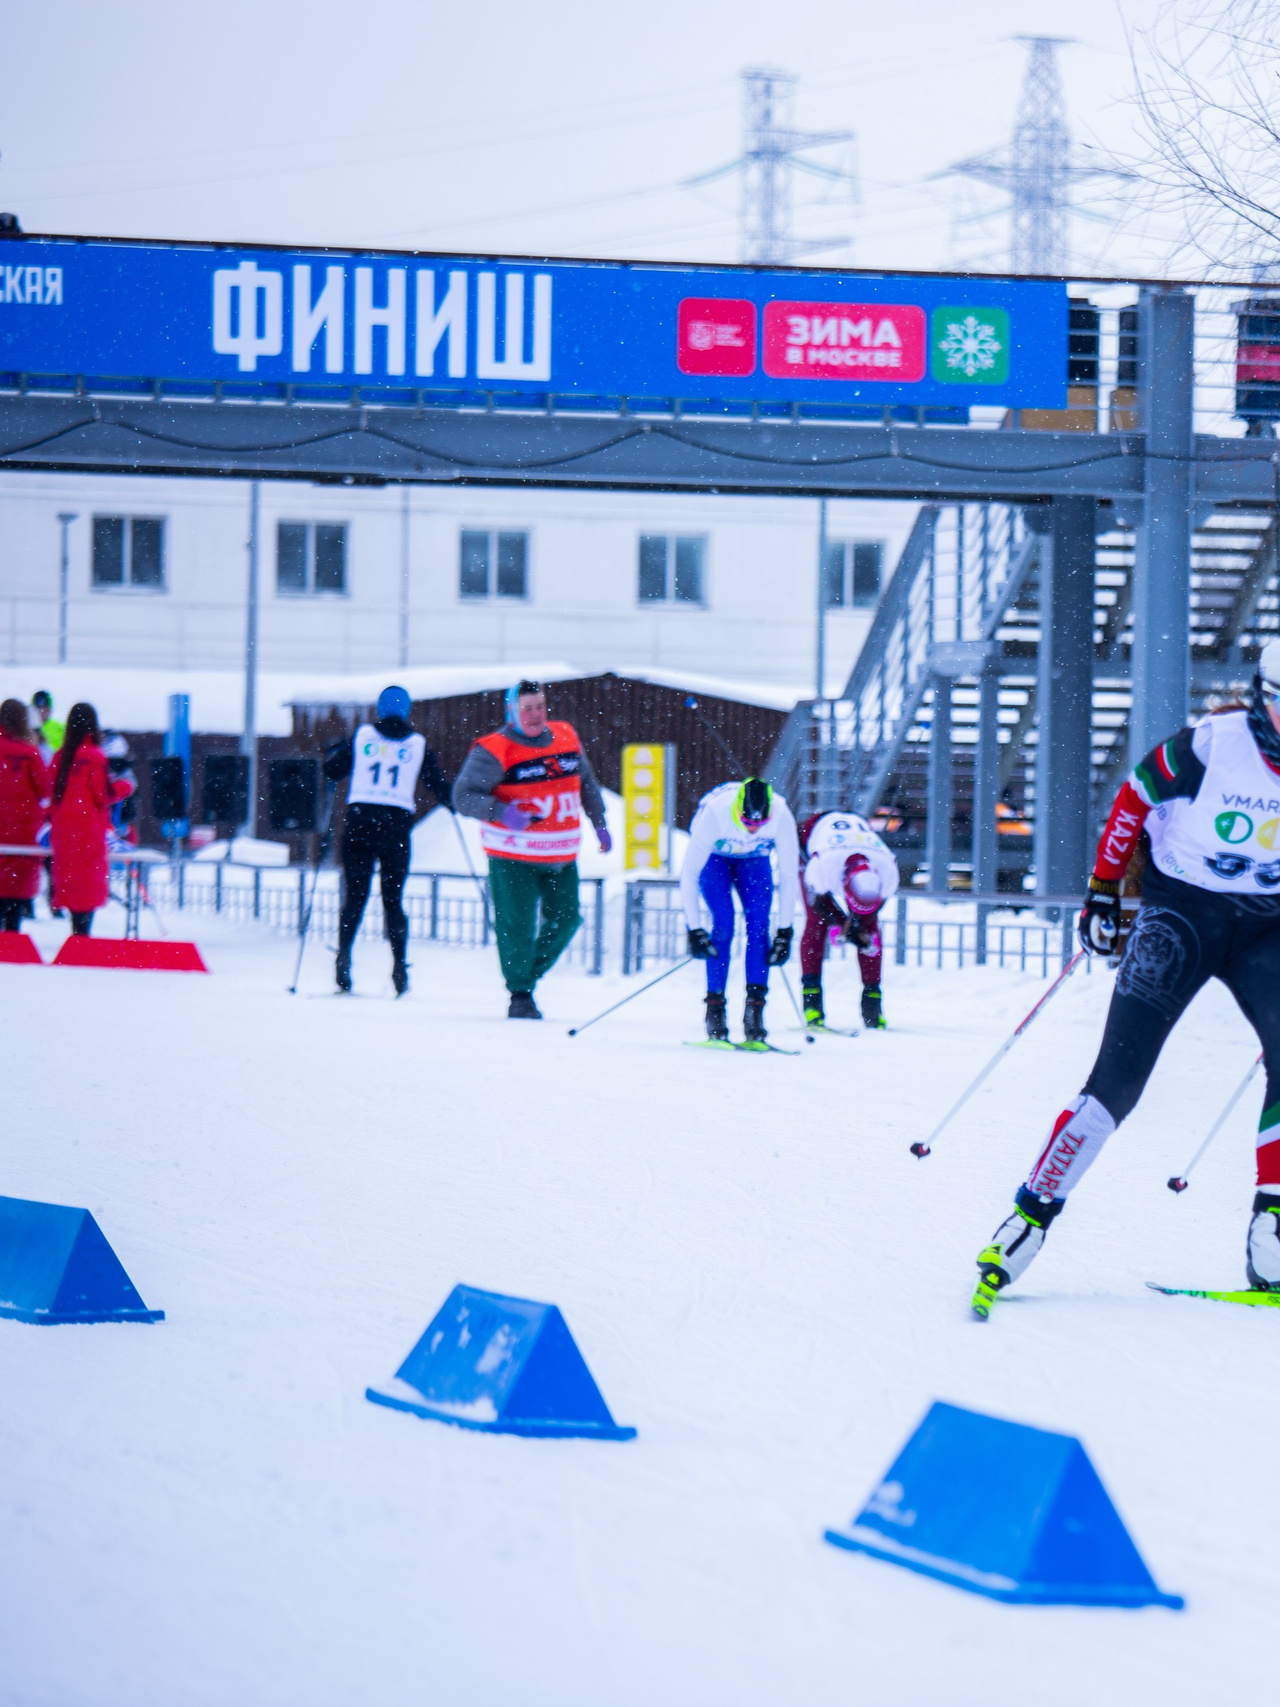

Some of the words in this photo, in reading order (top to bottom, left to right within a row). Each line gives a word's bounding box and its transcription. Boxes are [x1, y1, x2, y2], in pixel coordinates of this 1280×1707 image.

[0, 265, 64, 305] КАЯ
[212, 260, 553, 382] ФИНИШ
[785, 314, 901, 349] ЗИМА
[786, 346, 803, 364] В
[807, 348, 901, 368] МОСКВЕ
[368, 761, 400, 788] 11
